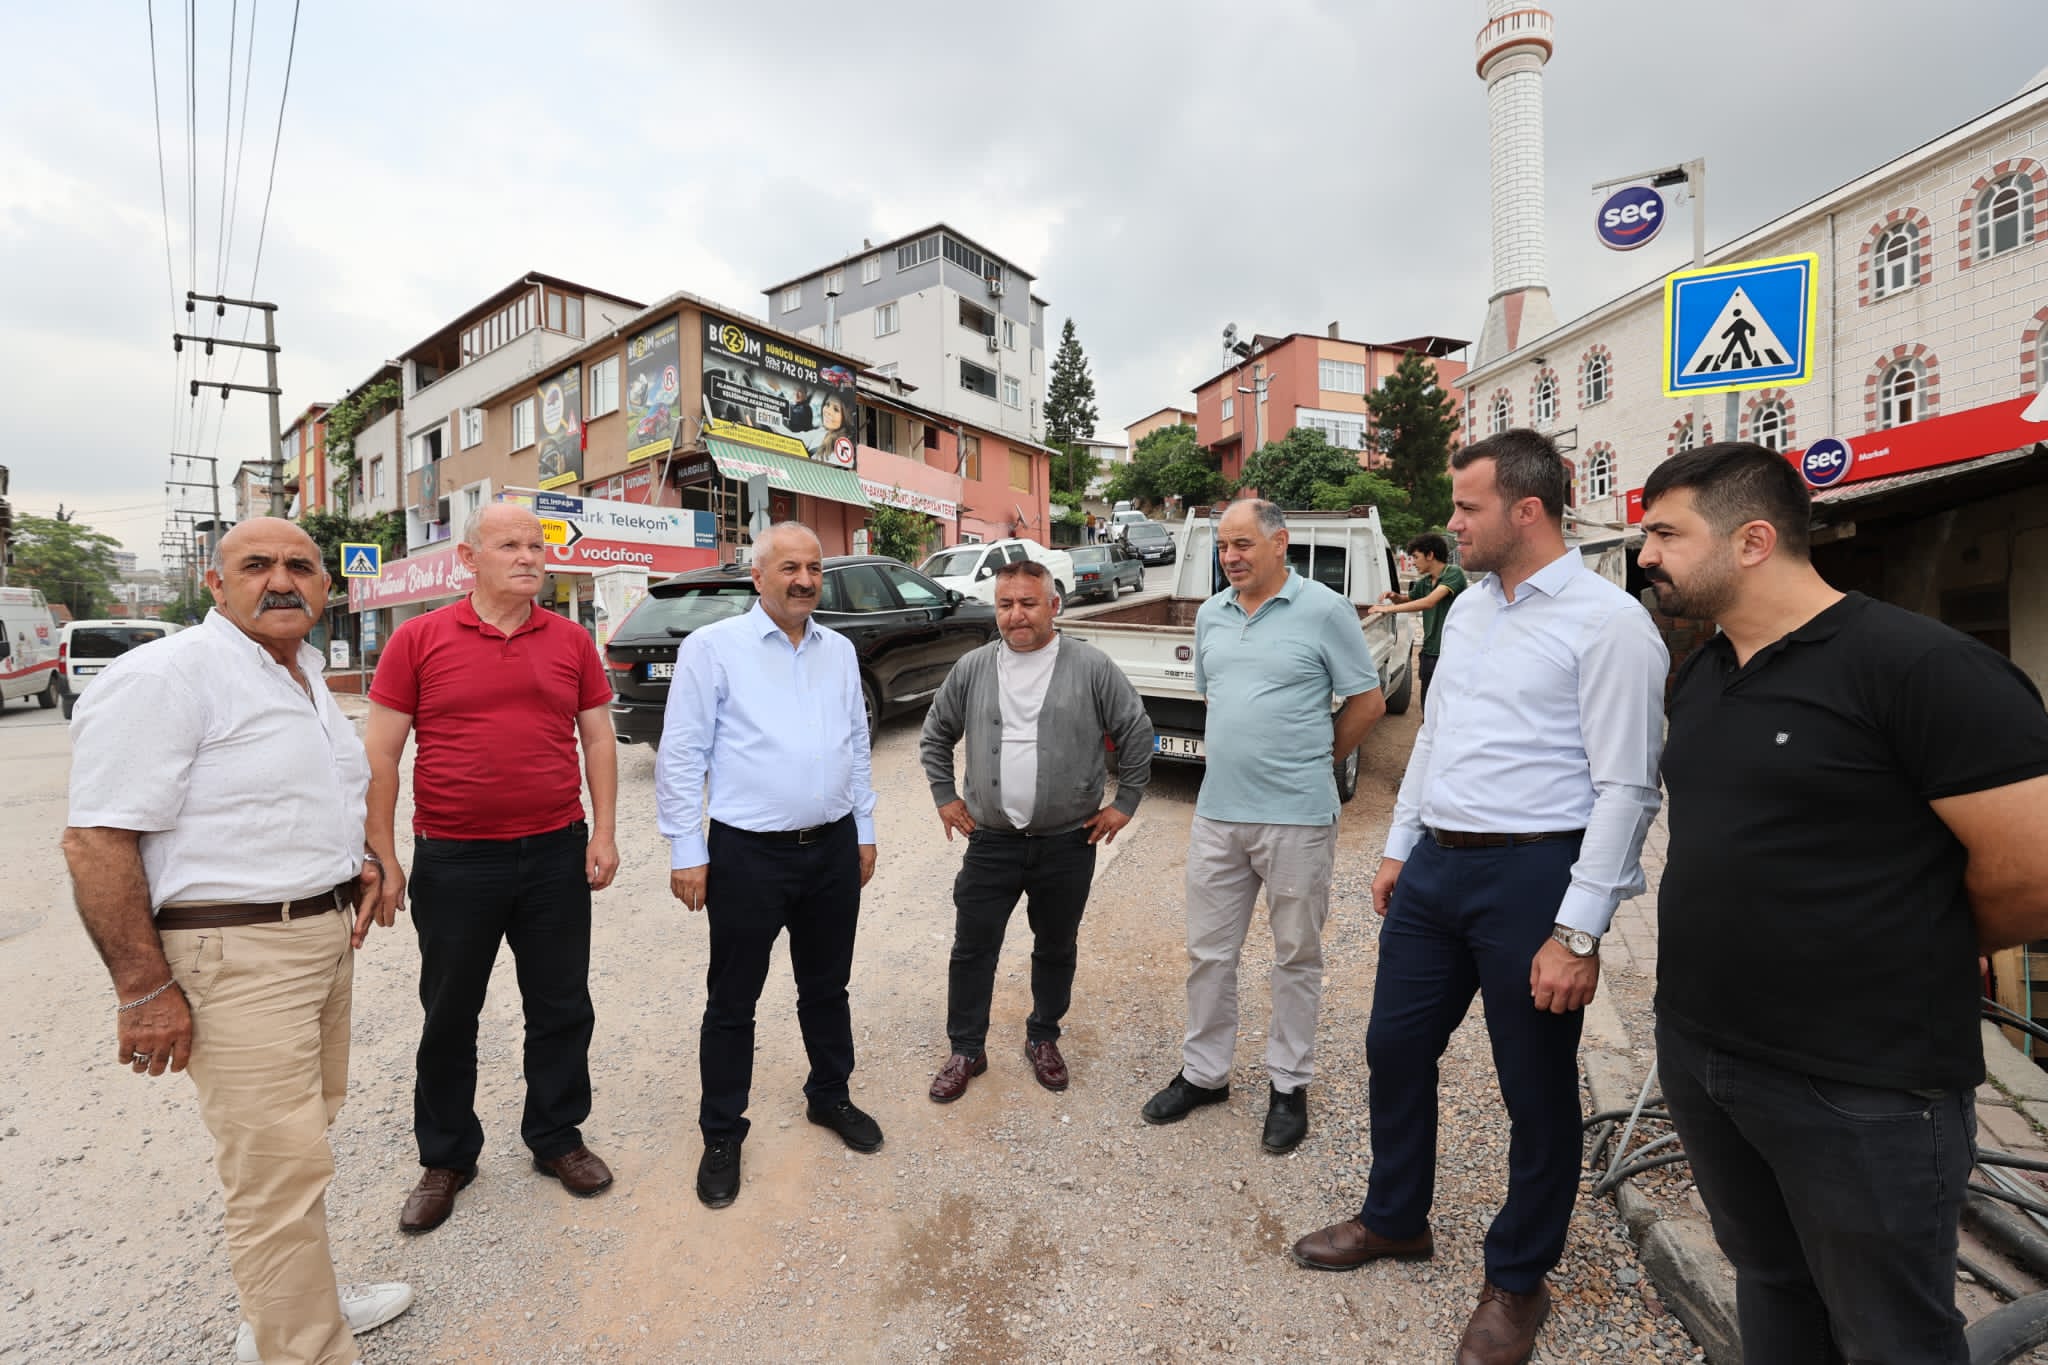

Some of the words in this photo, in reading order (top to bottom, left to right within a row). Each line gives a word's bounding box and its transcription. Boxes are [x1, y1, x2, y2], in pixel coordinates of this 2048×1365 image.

[1604, 200, 1657, 228] seç
[782, 361, 796, 377] 742
[804, 369, 818, 384] 743
[1807, 449, 1843, 470] seç
[609, 513, 669, 532] Telekom
[580, 547, 654, 563] vodafone
[1161, 738, 1174, 751] 81
[1184, 740, 1198, 753] EV
